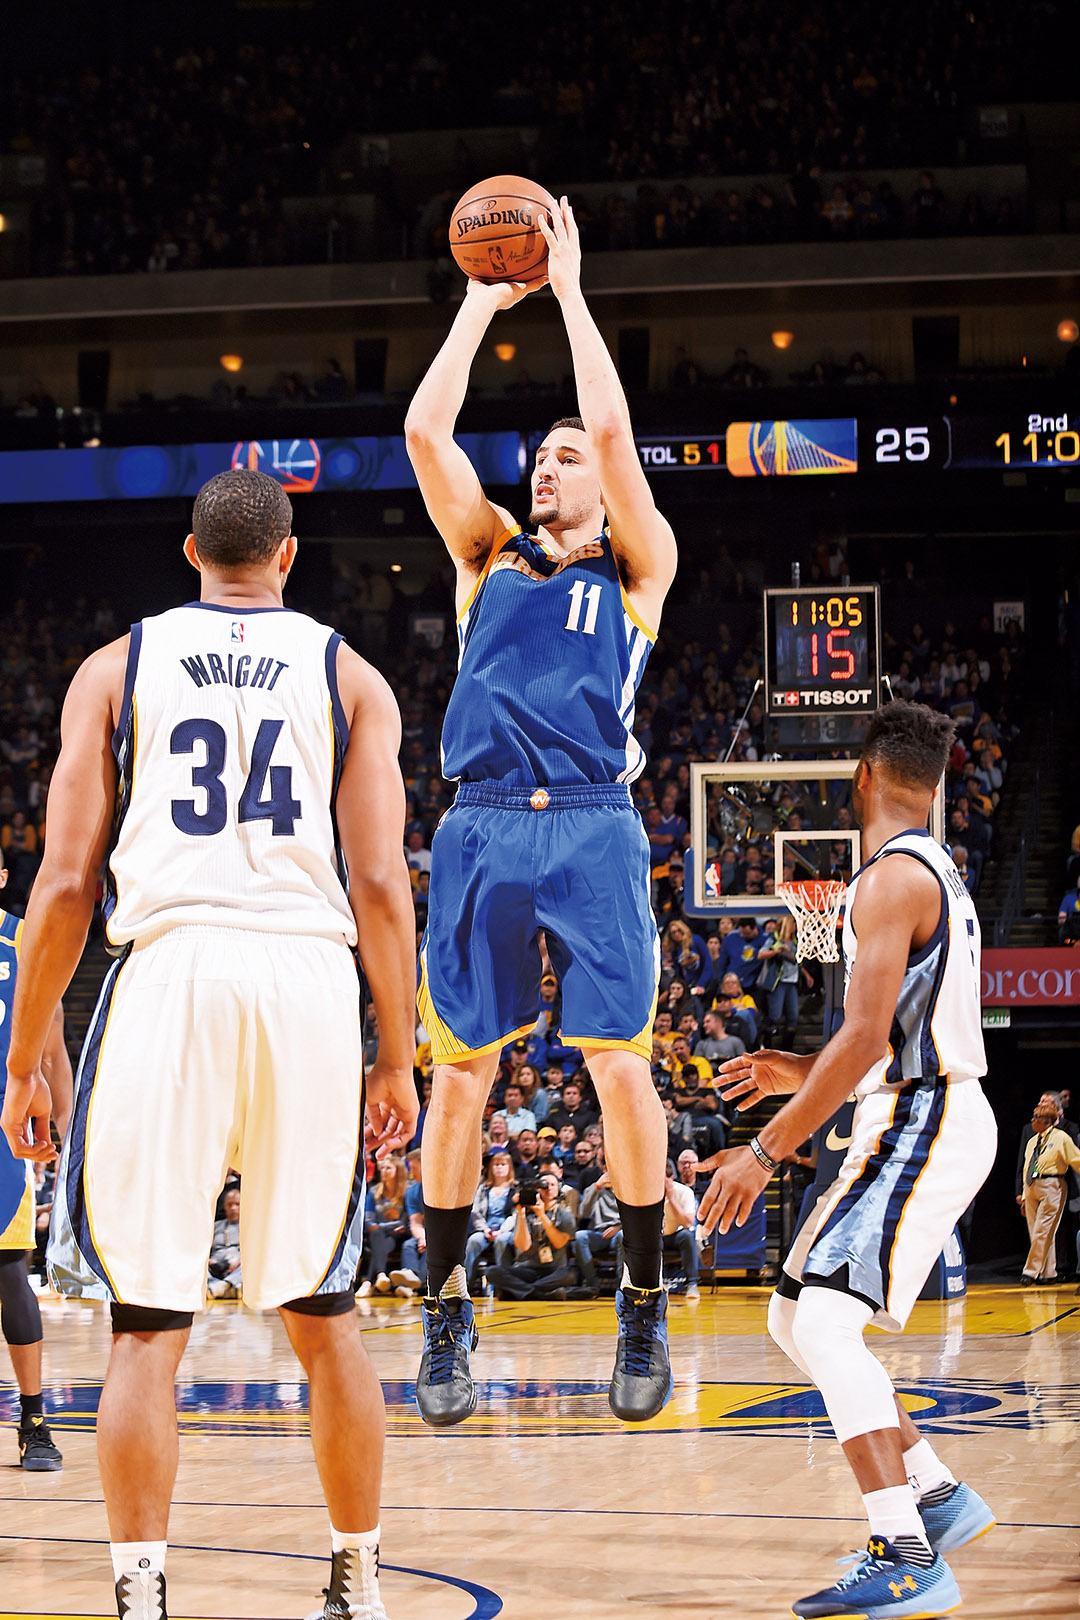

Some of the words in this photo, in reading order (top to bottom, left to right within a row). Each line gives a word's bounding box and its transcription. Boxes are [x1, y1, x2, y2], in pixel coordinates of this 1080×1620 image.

[457, 207, 532, 238] SPALDING
[1028, 413, 1068, 433] 2nd
[640, 446, 677, 465] TOL
[683, 443, 701, 465] 5
[707, 442, 719, 464] 1
[875, 426, 930, 463] 25
[995, 431, 1080, 465] 11:0
[564, 580, 603, 635] 11
[791, 596, 863, 628] 11:05
[811, 628, 855, 680] 15
[180, 653, 289, 691] WRIGHT
[800, 689, 872, 705] TISSOT
[170, 718, 302, 836] 34
[986, 1009, 1006, 1024] EXIT
